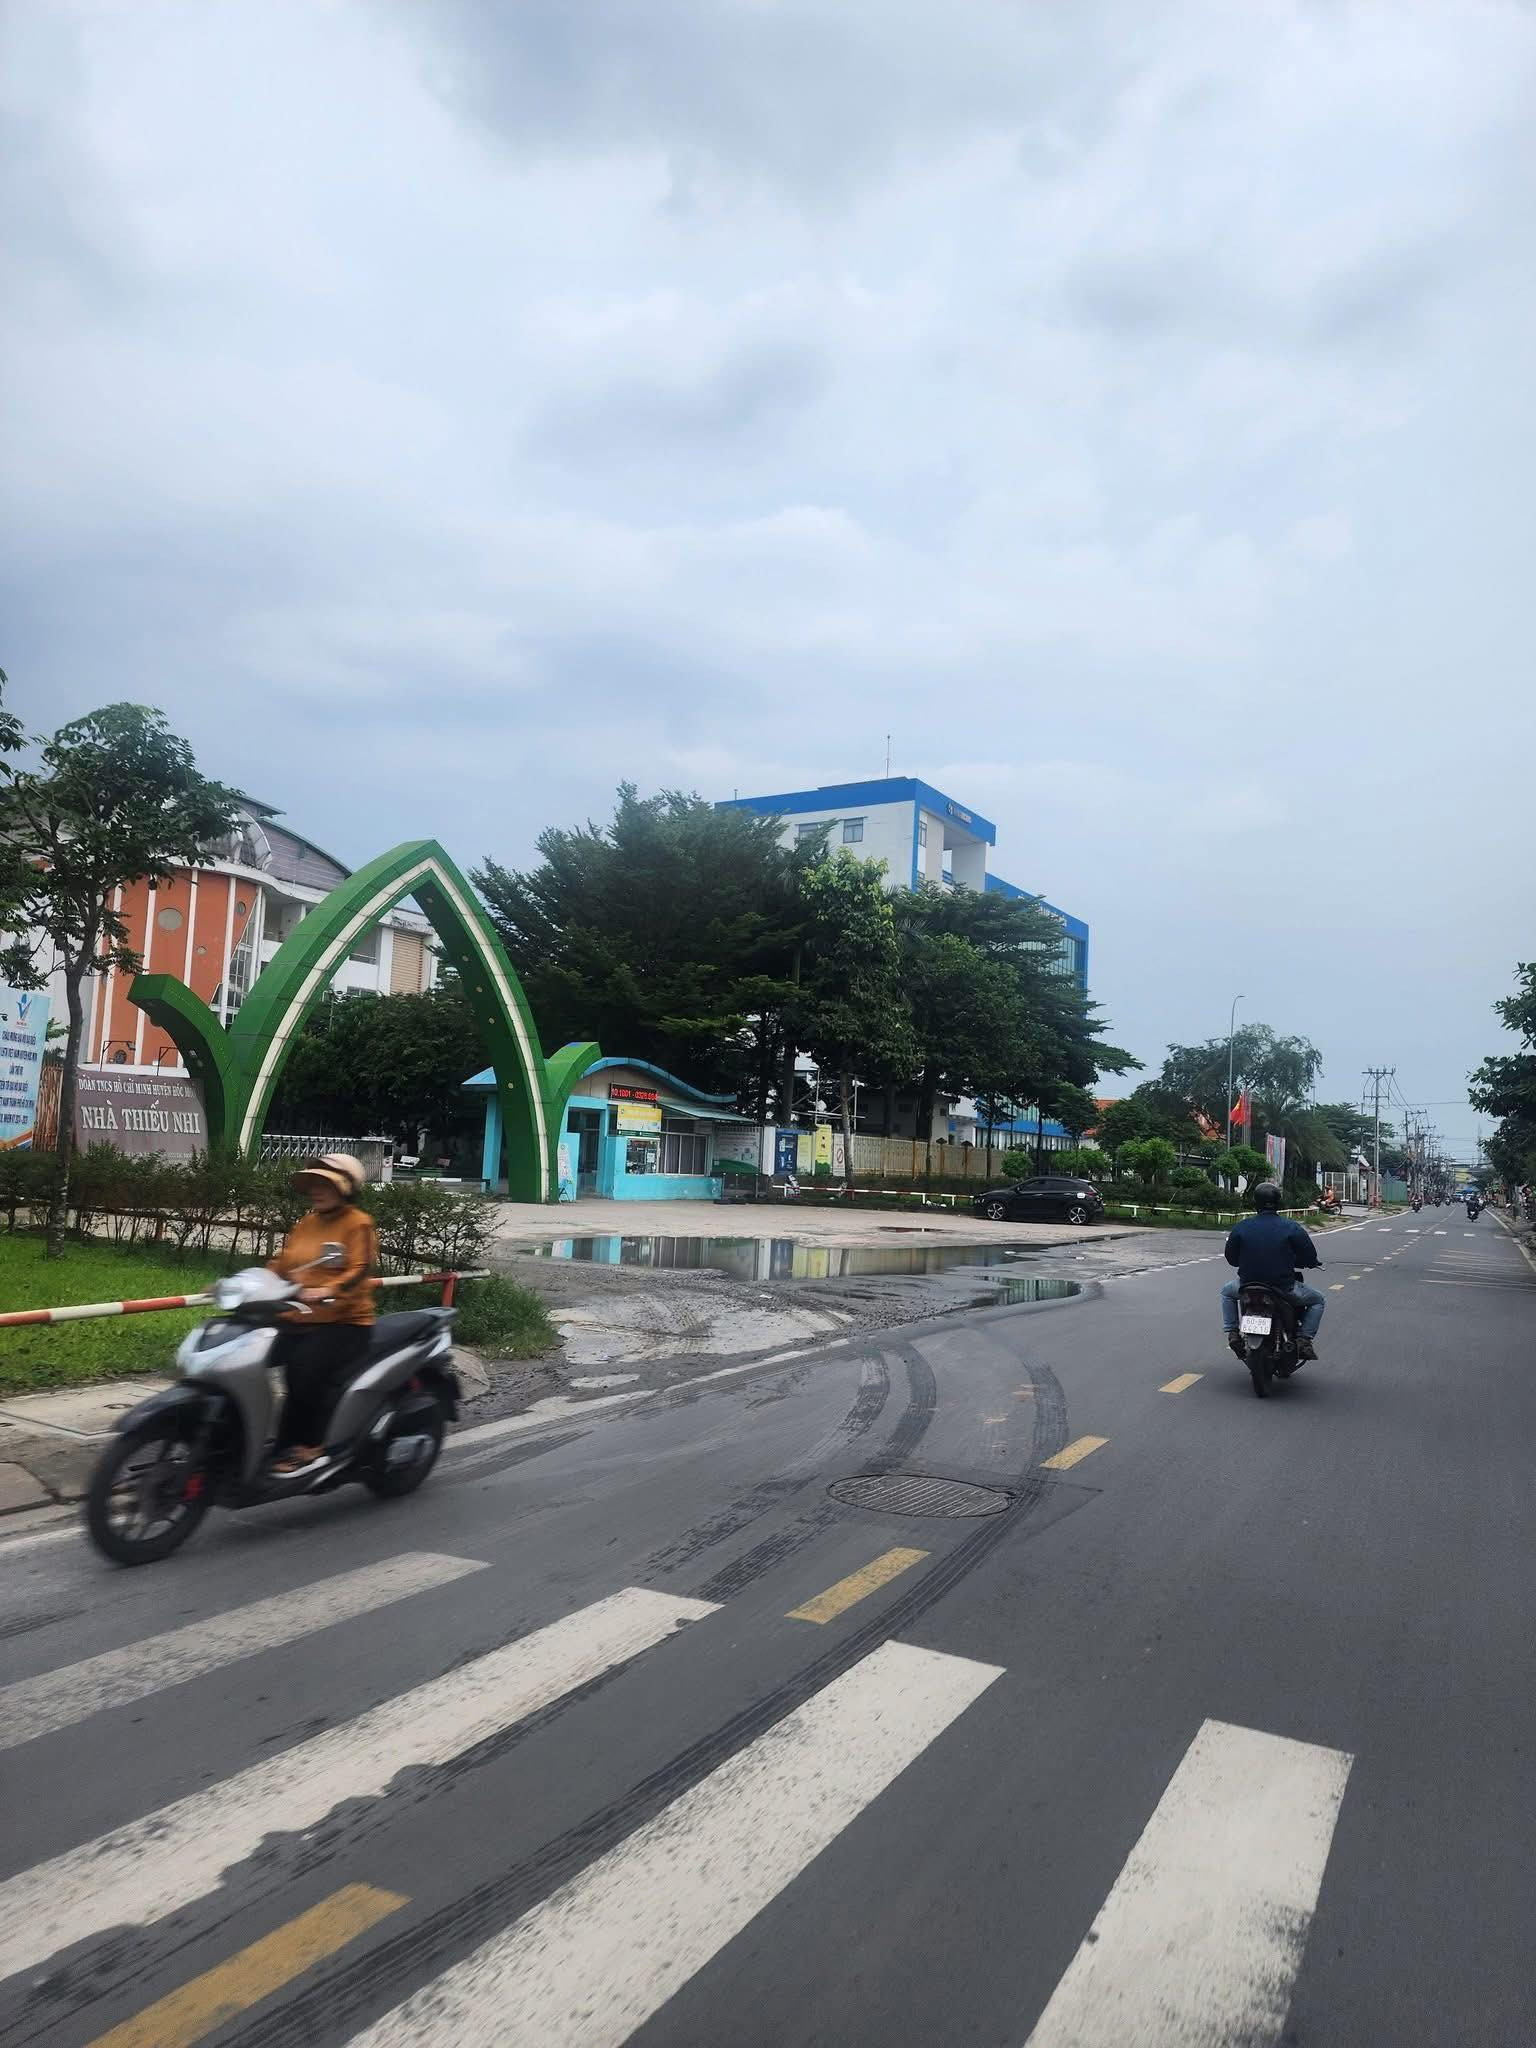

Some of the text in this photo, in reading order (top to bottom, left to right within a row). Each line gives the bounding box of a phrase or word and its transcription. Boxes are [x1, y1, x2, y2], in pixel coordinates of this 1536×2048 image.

[81, 1100, 201, 1134] NHÀ THIẾU NHI
